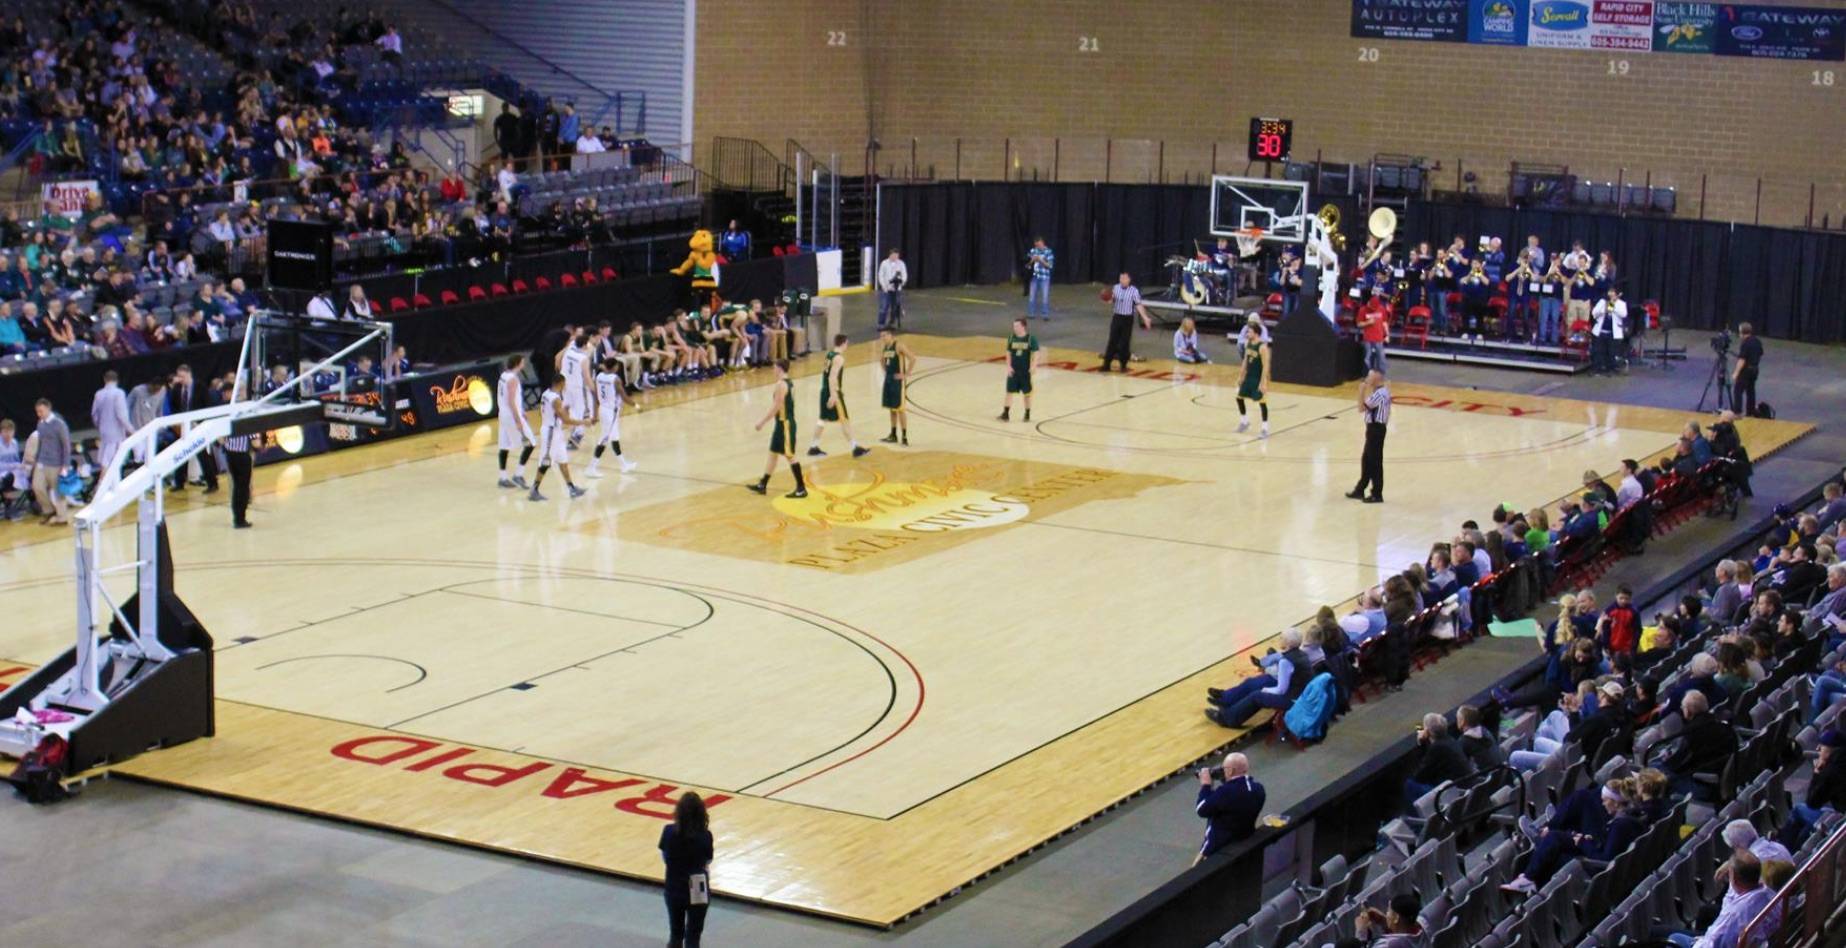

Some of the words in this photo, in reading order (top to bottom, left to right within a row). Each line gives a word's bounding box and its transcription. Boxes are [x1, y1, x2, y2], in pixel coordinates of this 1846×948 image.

[1625, 3, 1645, 12] CITY
[1656, 2, 1686, 16] Black
[1689, 4, 1716, 17] Hills
[1360, 9, 1459, 23] AUTOPLEX
[1483, 23, 1514, 33] WORLD
[828, 31, 847, 46] 22
[1078, 36, 1099, 51] 21
[1358, 47, 1379, 62] 20
[1607, 60, 1630, 75] 19
[1811, 70, 1835, 86] 18
[1257, 134, 1281, 157] 30
[1390, 396, 1547, 416] CITY
[787, 534, 919, 569] PLAZA
[900, 503, 1010, 533] CIVIC
[990, 470, 1120, 505] CENTER
[330, 736, 734, 821] RAPID
